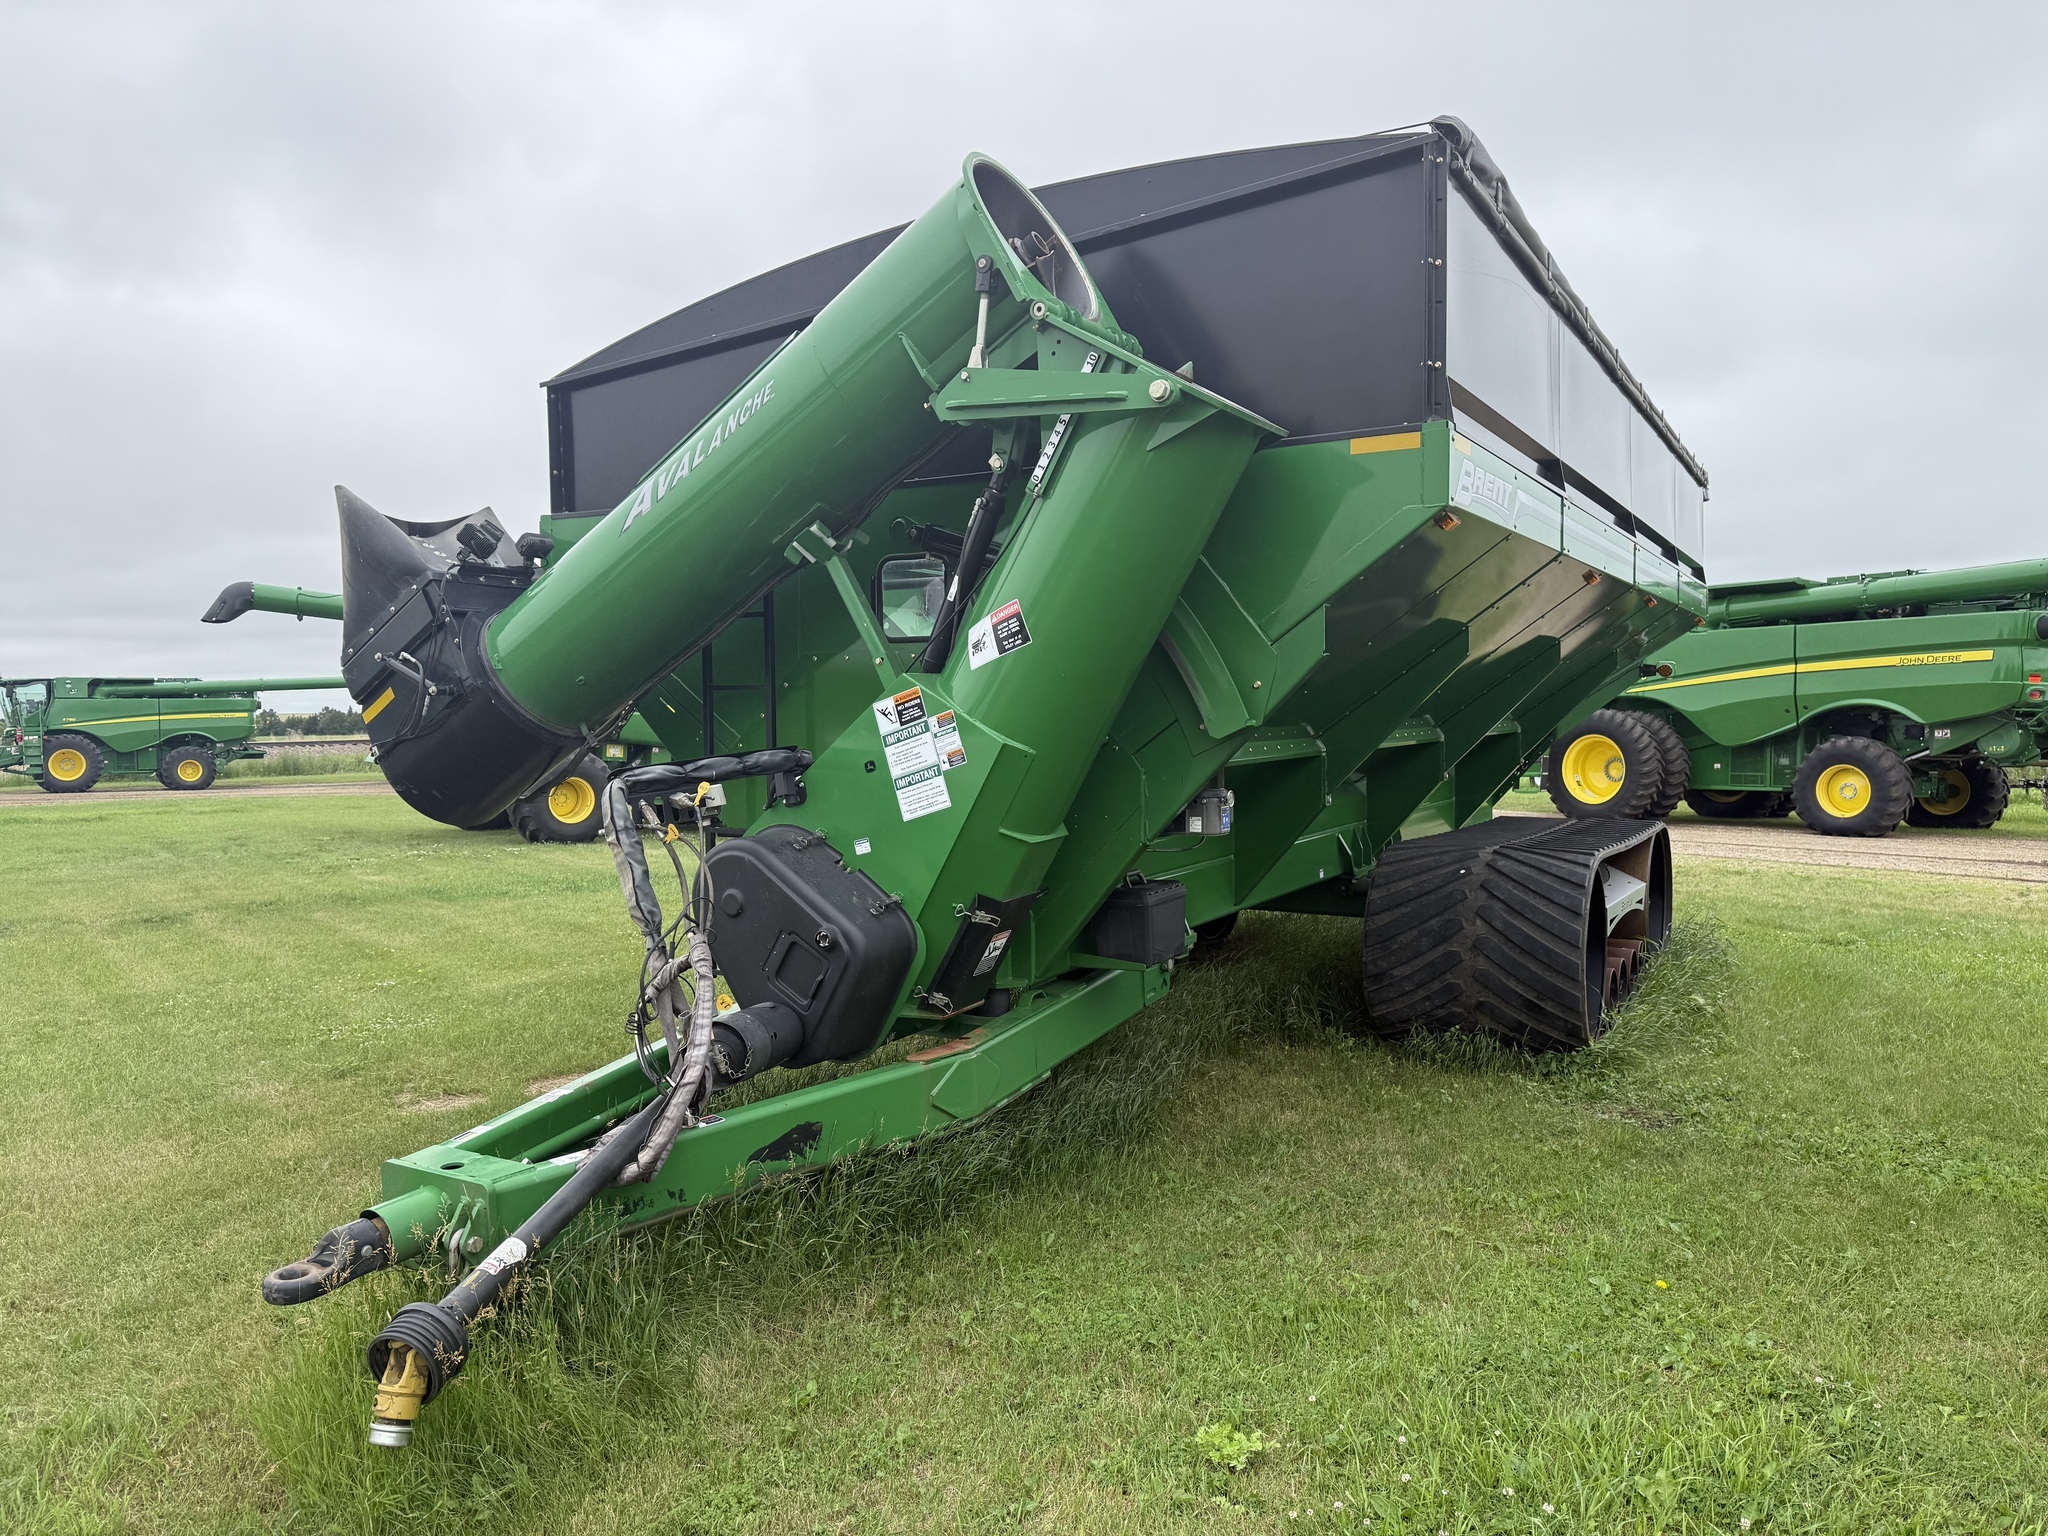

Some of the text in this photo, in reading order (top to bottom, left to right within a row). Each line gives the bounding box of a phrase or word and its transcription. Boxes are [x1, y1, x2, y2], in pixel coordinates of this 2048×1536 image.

[1032, 474, 1040, 482] 0
[1043, 452, 1051, 460] 2
[1048, 440, 1056, 449] 3
[1054, 429, 1062, 437] 4
[1059, 417, 1067, 426] 5
[1086, 353, 1098, 367] 10
[997, 603, 1019, 620] DANGER
[1897, 654, 1962, 665] JOHN DEERE
[885, 722, 926, 745] IMPORTANT
[895, 766, 939, 789] IMPORTANT
